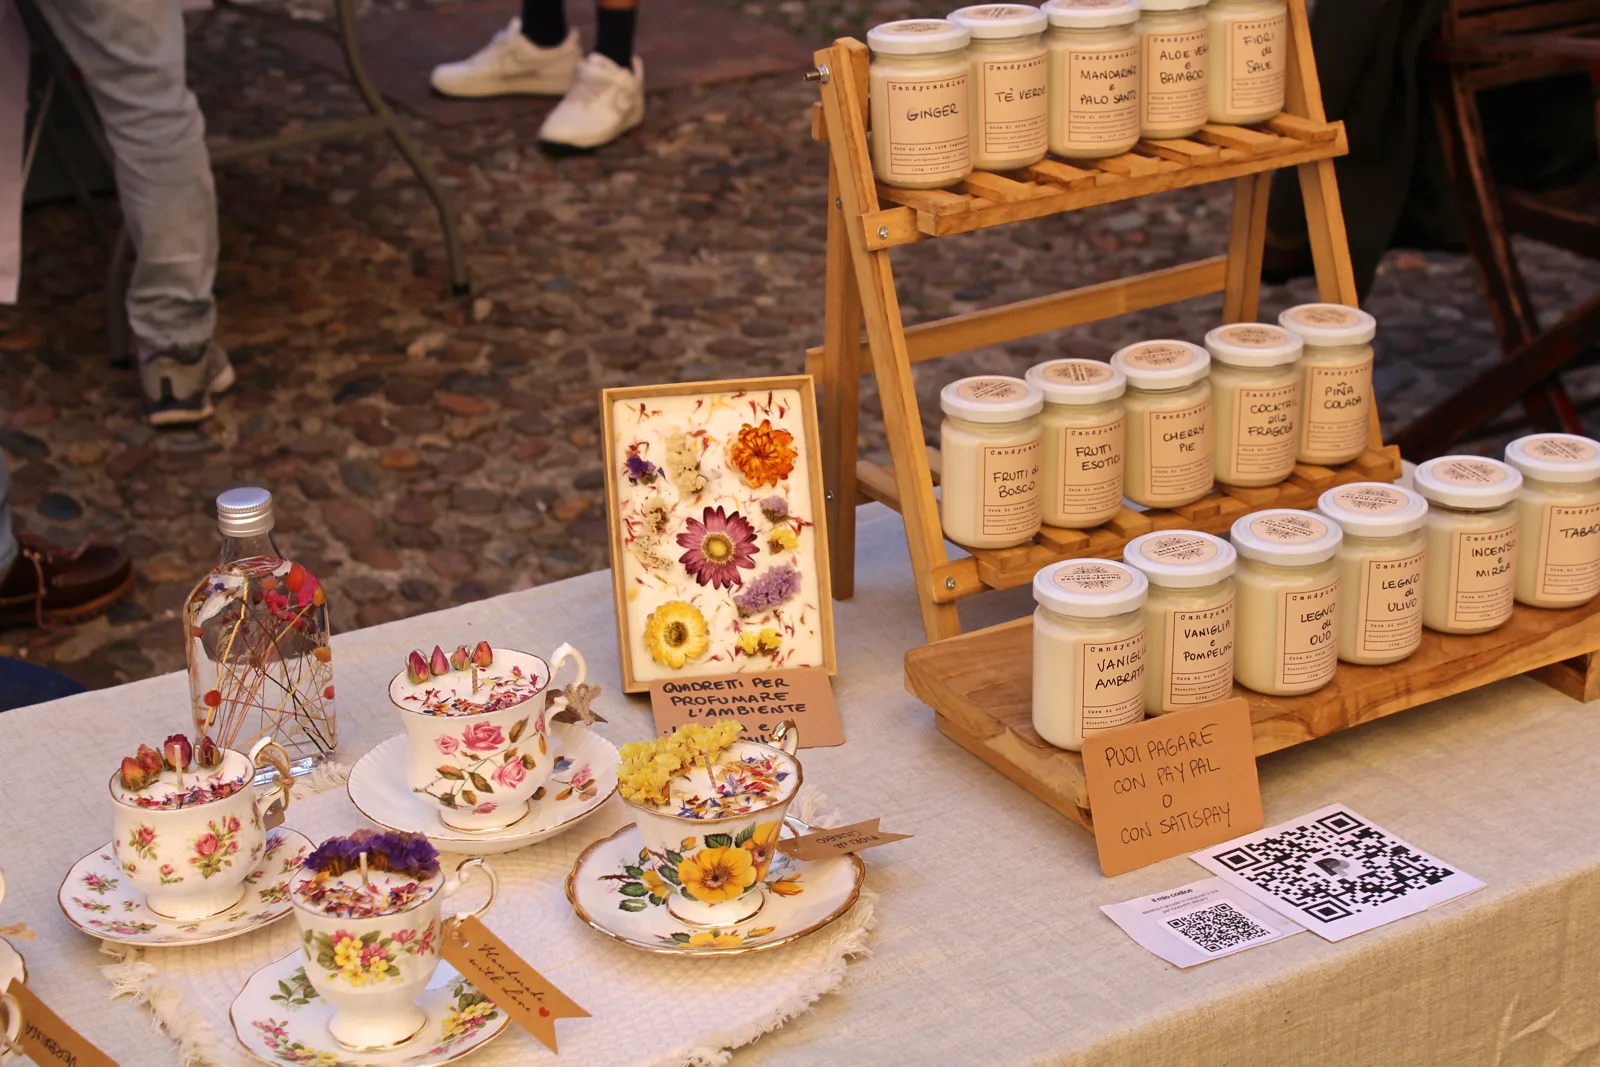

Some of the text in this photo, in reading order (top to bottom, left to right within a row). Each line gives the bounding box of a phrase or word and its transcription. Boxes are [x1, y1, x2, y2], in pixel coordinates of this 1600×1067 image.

[1243, 32, 1275, 45] FIORI
[1160, 50, 1189, 60] ALOE
[1081, 65, 1137, 80] MANDARINO
[1246, 60, 1272, 73] SALE
[1160, 70, 1203, 84] BAMBOO
[994, 85, 1046, 102] TÈ VERDE
[1081, 90, 1137, 105] PALO SANTO
[907, 103, 959, 121] GINGER
[1325, 382, 1354, 396] PIÑA
[1250, 400, 1298, 414] COCKTAIL
[1324, 396, 1362, 409] COLADA
[1268, 414, 1286, 424] alla
[1163, 423, 1205, 442] CHERRY
[1248, 422, 1293, 436] FRAGOLA
[1076, 444, 1112, 457] FRUTTI
[1179, 443, 1195, 452] PIE
[993, 470, 1028, 482] FRUTTI
[999, 481, 1035, 498] BOSCO
[1472, 539, 1515, 557] INCENSO
[1476, 562, 1510, 577] MIRRA
[1382, 573, 1419, 590] LEGNO
[1300, 602, 1336, 623] LEGNO
[1388, 598, 1417, 612] ULIVO
[1184, 620, 1230, 638] VANIGLIA
[1310, 630, 1331, 645] OUD
[1183, 641, 1232, 661] POMPELMO
[663, 677, 790, 694] QUADRETTI PER
[670, 692, 789, 707] PROFUMARE
[688, 704, 807, 718] L'AMBIENTE
[1105, 723, 1218, 767] PUOI PAGARE
[1114, 773, 1146, 794] CON
[1162, 794, 1172, 808] O
[1120, 802, 1231, 844] CON SATISPAY
[1170, 888, 1193, 897] codice
[469, 958, 504, 984] with
[478, 944, 545, 1002] Handmade
